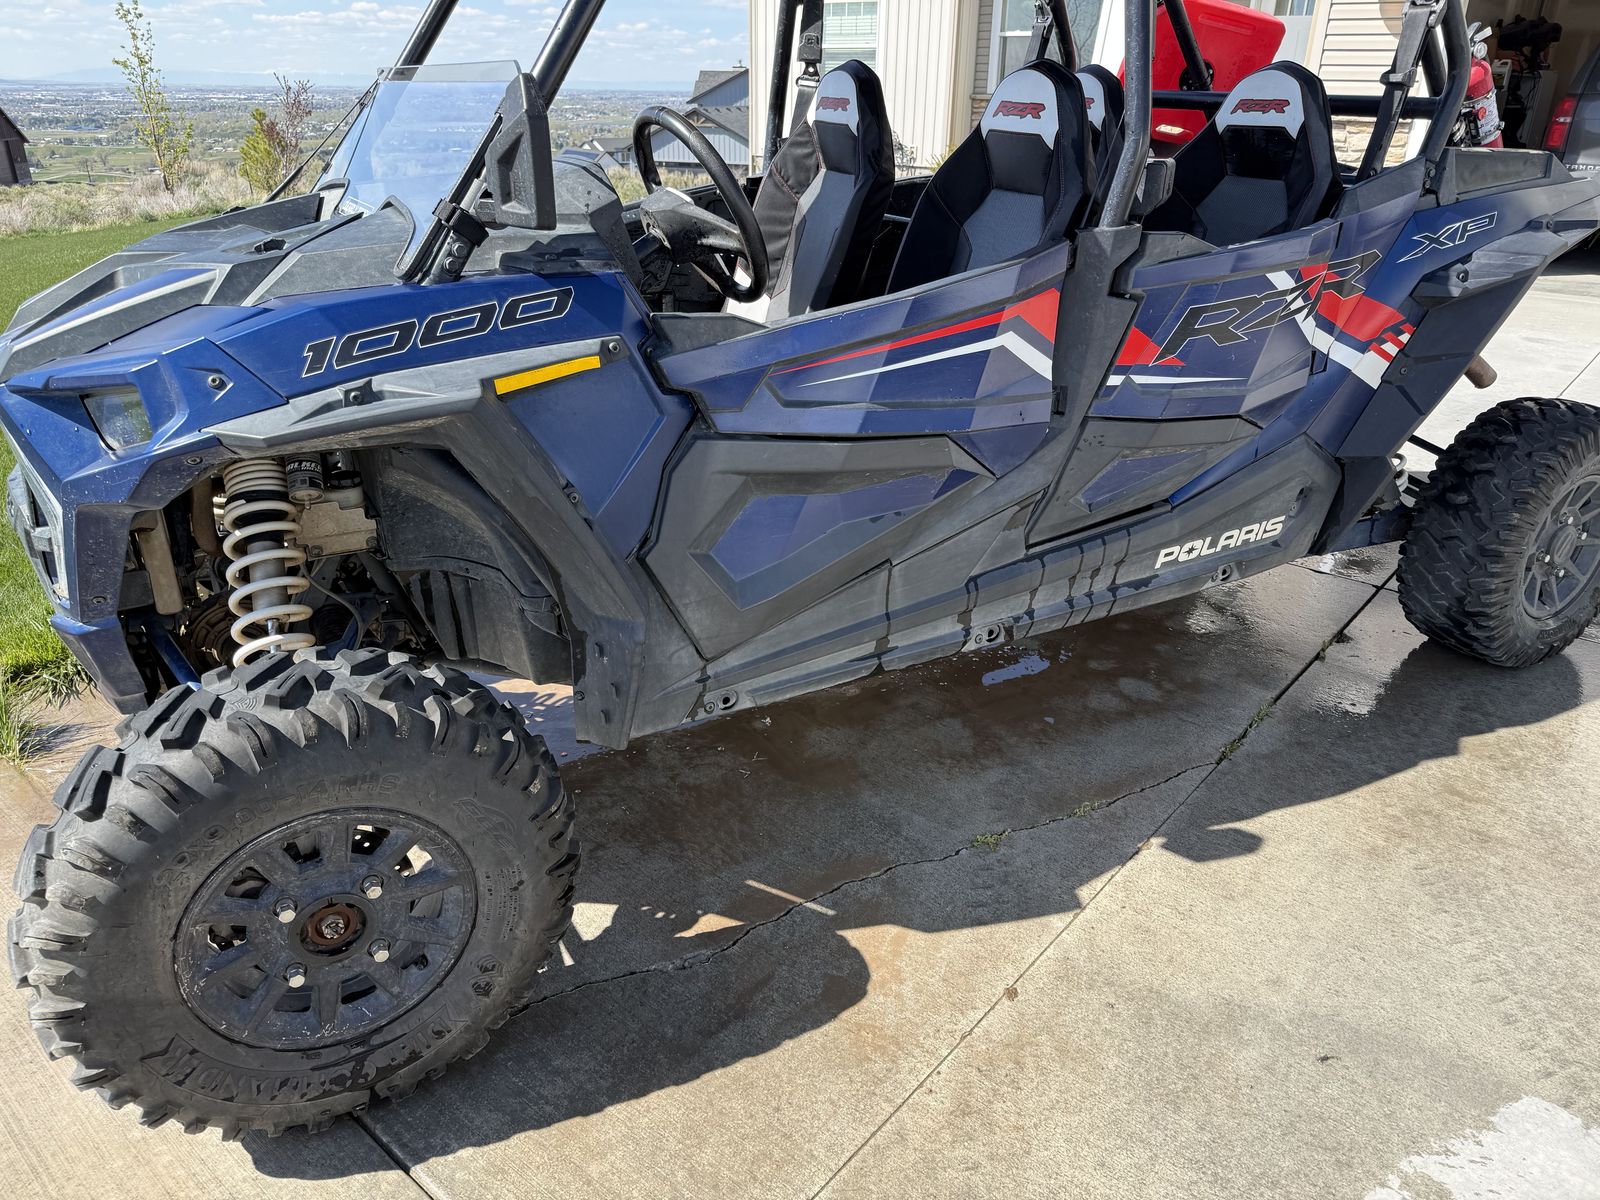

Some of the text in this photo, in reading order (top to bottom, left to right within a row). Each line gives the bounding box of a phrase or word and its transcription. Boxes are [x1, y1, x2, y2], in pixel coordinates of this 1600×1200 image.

[993, 100, 1046, 119] RZR
[1230, 98, 1290, 114] RZR
[1397, 211, 1498, 263] XP
[301, 286, 574, 378] 1000
[1149, 249, 1382, 367] RZR
[1154, 515, 1286, 570] POLARIS
